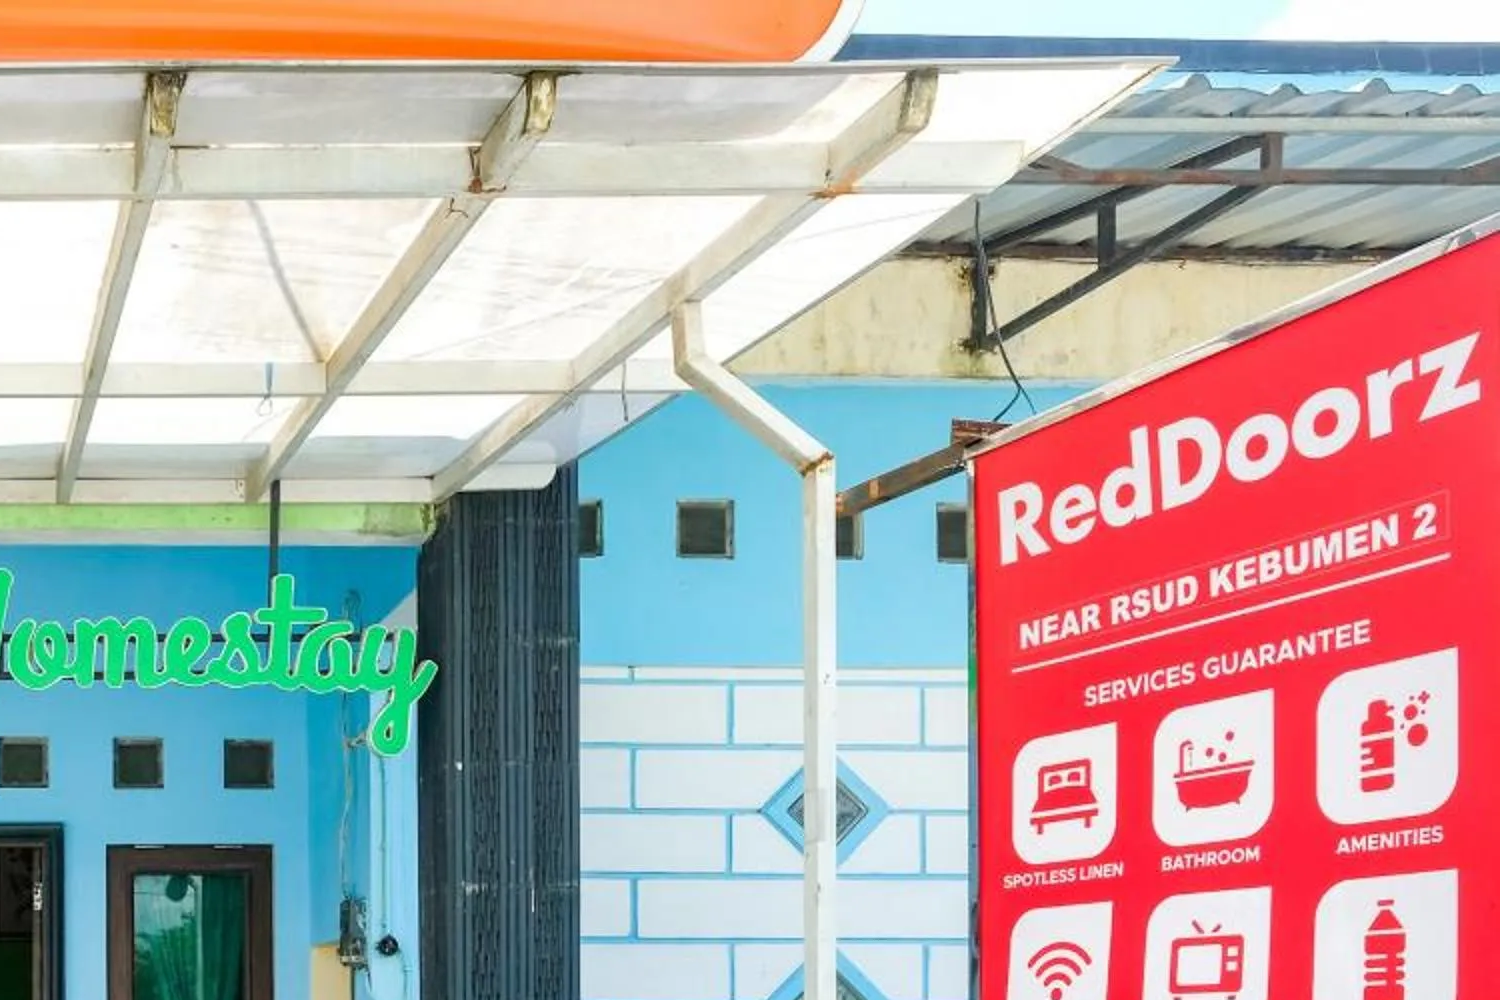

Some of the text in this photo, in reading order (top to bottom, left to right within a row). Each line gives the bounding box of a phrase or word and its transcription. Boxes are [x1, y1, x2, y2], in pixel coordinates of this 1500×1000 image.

[997, 331, 1482, 566] RedDoorz
[1019, 502, 1438, 650] NEAR RSUD KEBUMEN 2
[1084, 619, 1372, 706] SERVICES GUARANTEE
[1160, 846, 1261, 873] BATHROOM
[1335, 825, 1444, 855] AMENITIES
[1003, 862, 1124, 889] SPOTLESS LINEN
